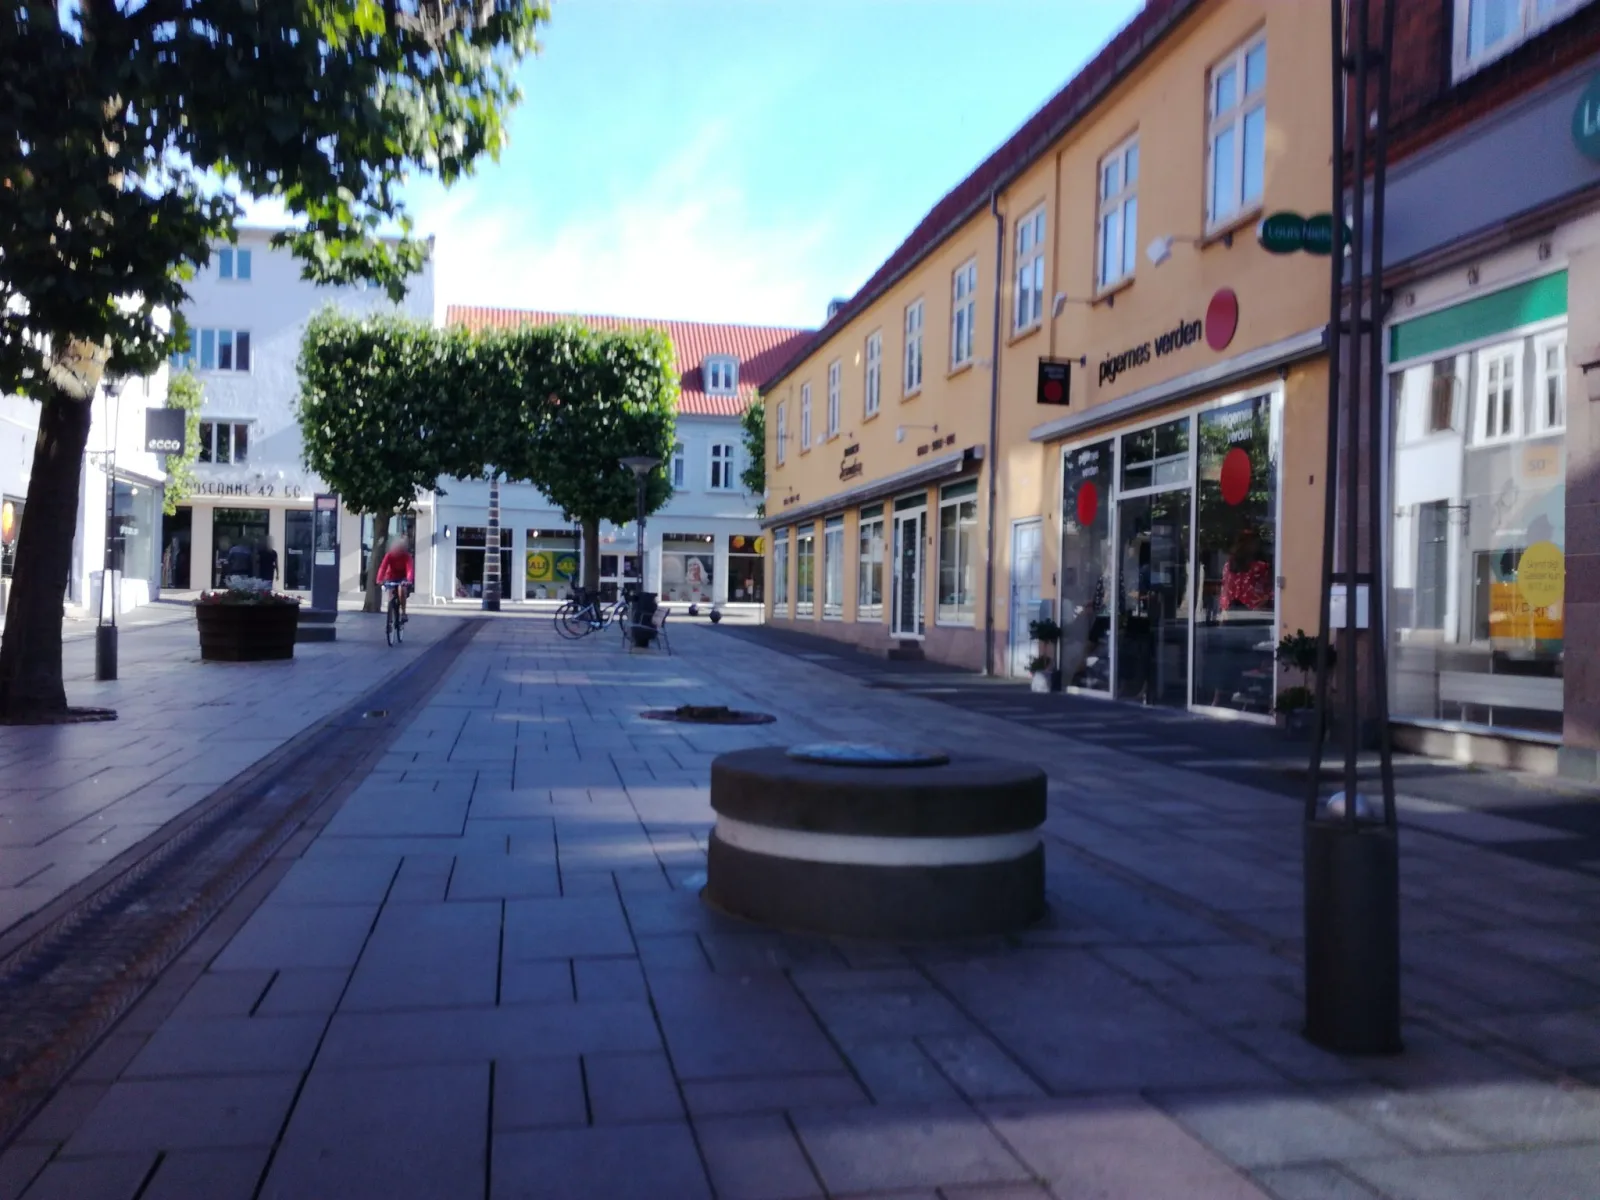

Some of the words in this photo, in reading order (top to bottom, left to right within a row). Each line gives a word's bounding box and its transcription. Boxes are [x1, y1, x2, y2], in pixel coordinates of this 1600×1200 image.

[1268, 224, 1301, 241] Louis
[1098, 341, 1151, 388] pigernes
[1154, 318, 1203, 358] verden
[148, 439, 181, 450] ecco
[257, 484, 274, 497] 42
